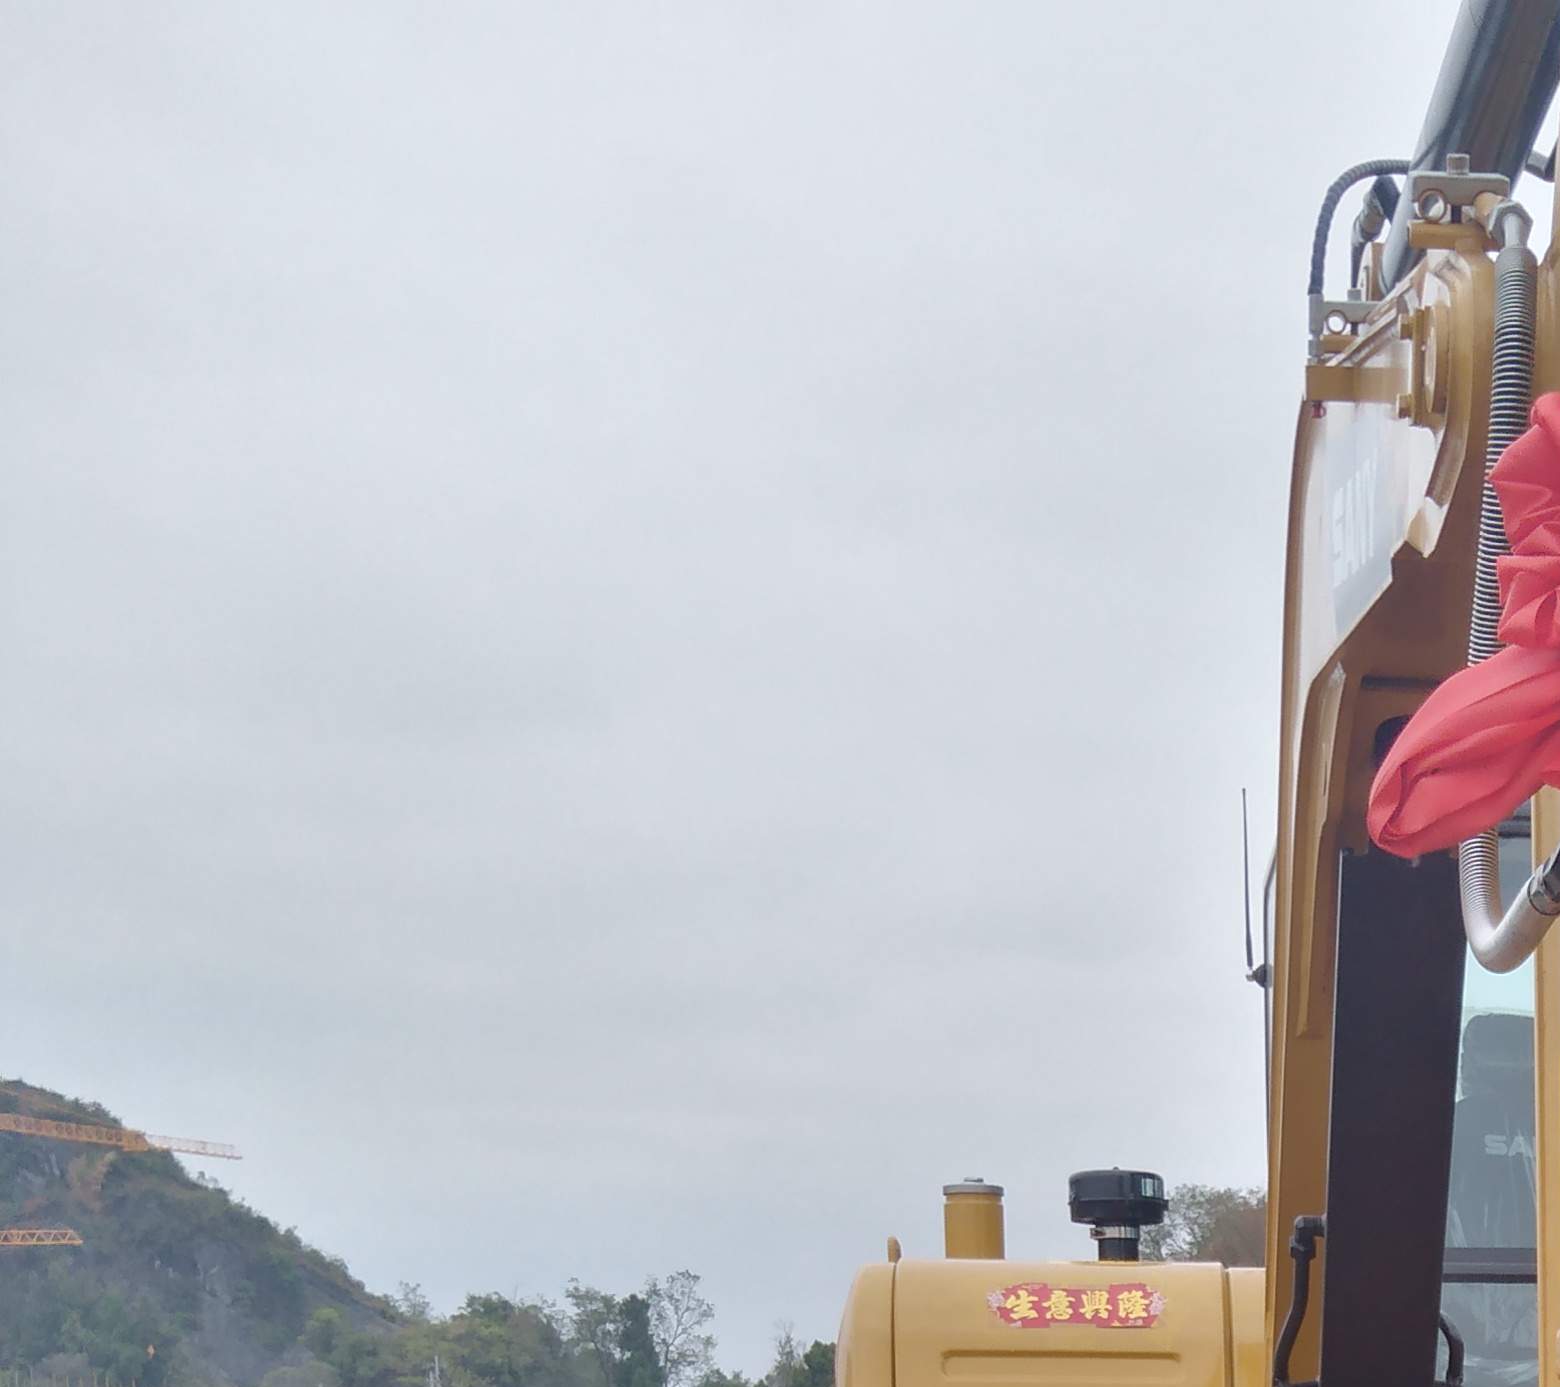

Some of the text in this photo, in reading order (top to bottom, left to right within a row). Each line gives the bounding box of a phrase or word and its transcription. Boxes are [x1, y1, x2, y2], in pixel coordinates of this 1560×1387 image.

[1484, 1134, 1536, 1156] SA
[1004, 1289, 1150, 1321] 生意興隆
